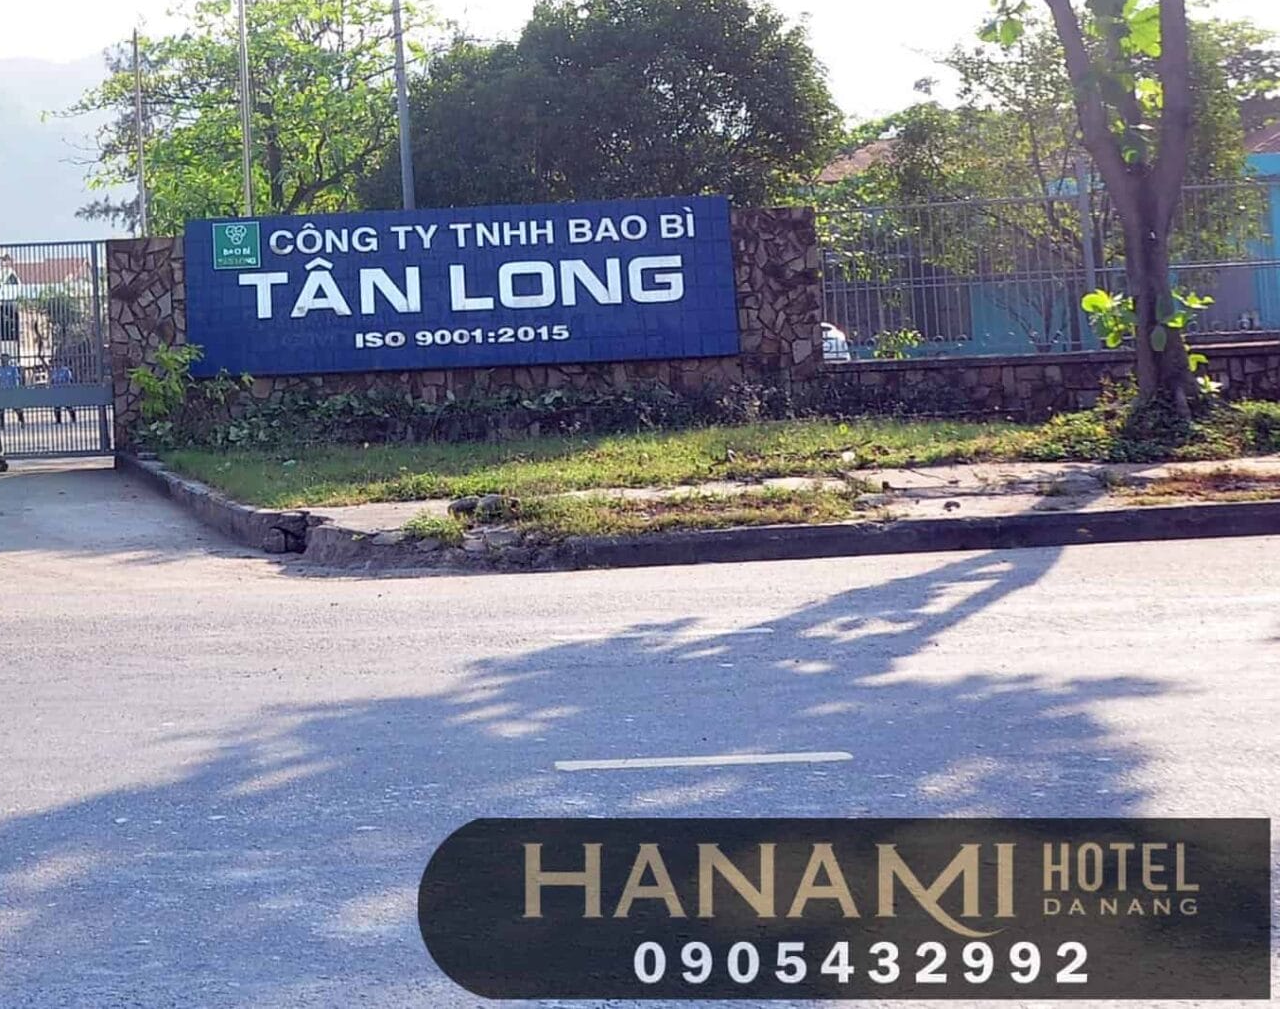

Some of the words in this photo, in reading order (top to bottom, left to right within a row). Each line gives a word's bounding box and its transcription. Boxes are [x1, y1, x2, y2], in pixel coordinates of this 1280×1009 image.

[269, 222, 379, 255] CÔNG
[389, 224, 438, 250] TY
[449, 219, 554, 248] TNHH
[568, 214, 648, 243] BAO
[659, 206, 695, 238] BÌ
[238, 256, 421, 319] TÂN
[449, 254, 685, 311] LONG
[355, 330, 406, 348] ISO
[415, 325, 570, 346] 9001:2015
